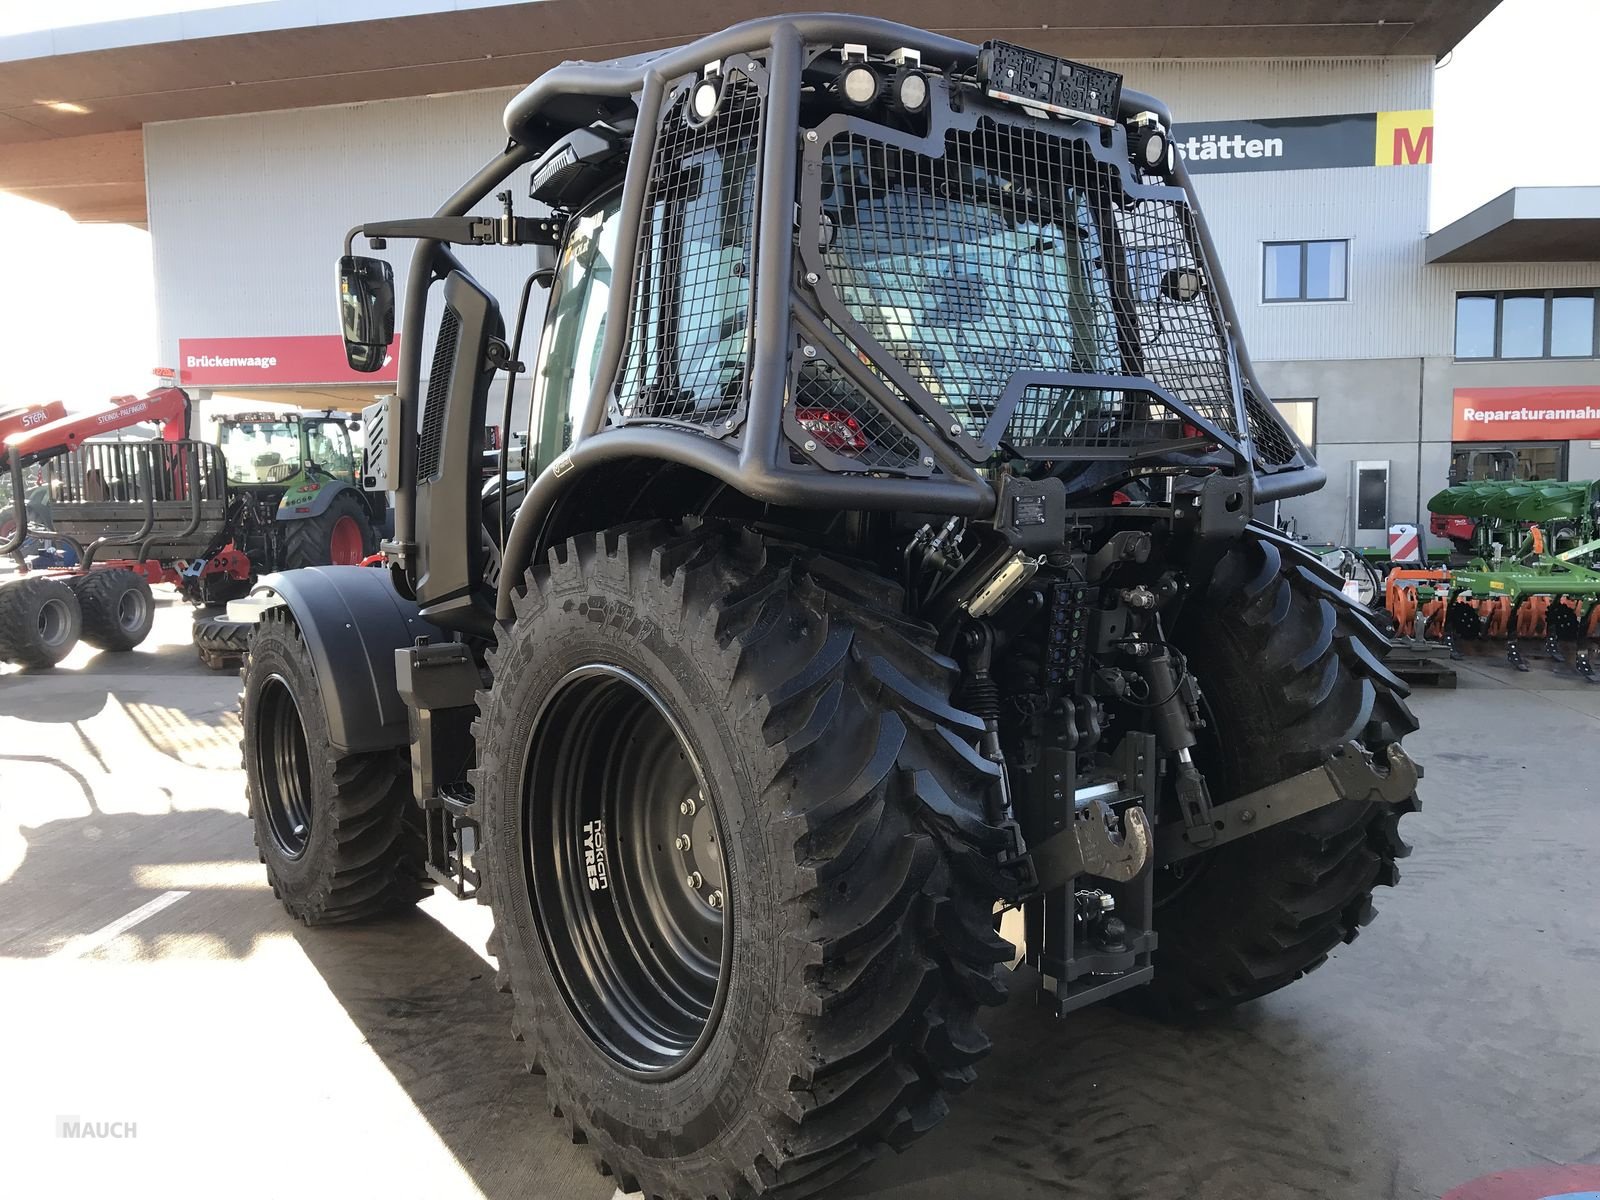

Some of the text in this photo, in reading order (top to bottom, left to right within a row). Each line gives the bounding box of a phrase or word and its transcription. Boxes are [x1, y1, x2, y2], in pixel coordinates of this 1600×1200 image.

[187, 355, 277, 368] Brückenwaage
[22, 411, 48, 427] STEPA
[583, 821, 600, 891] TYRES
